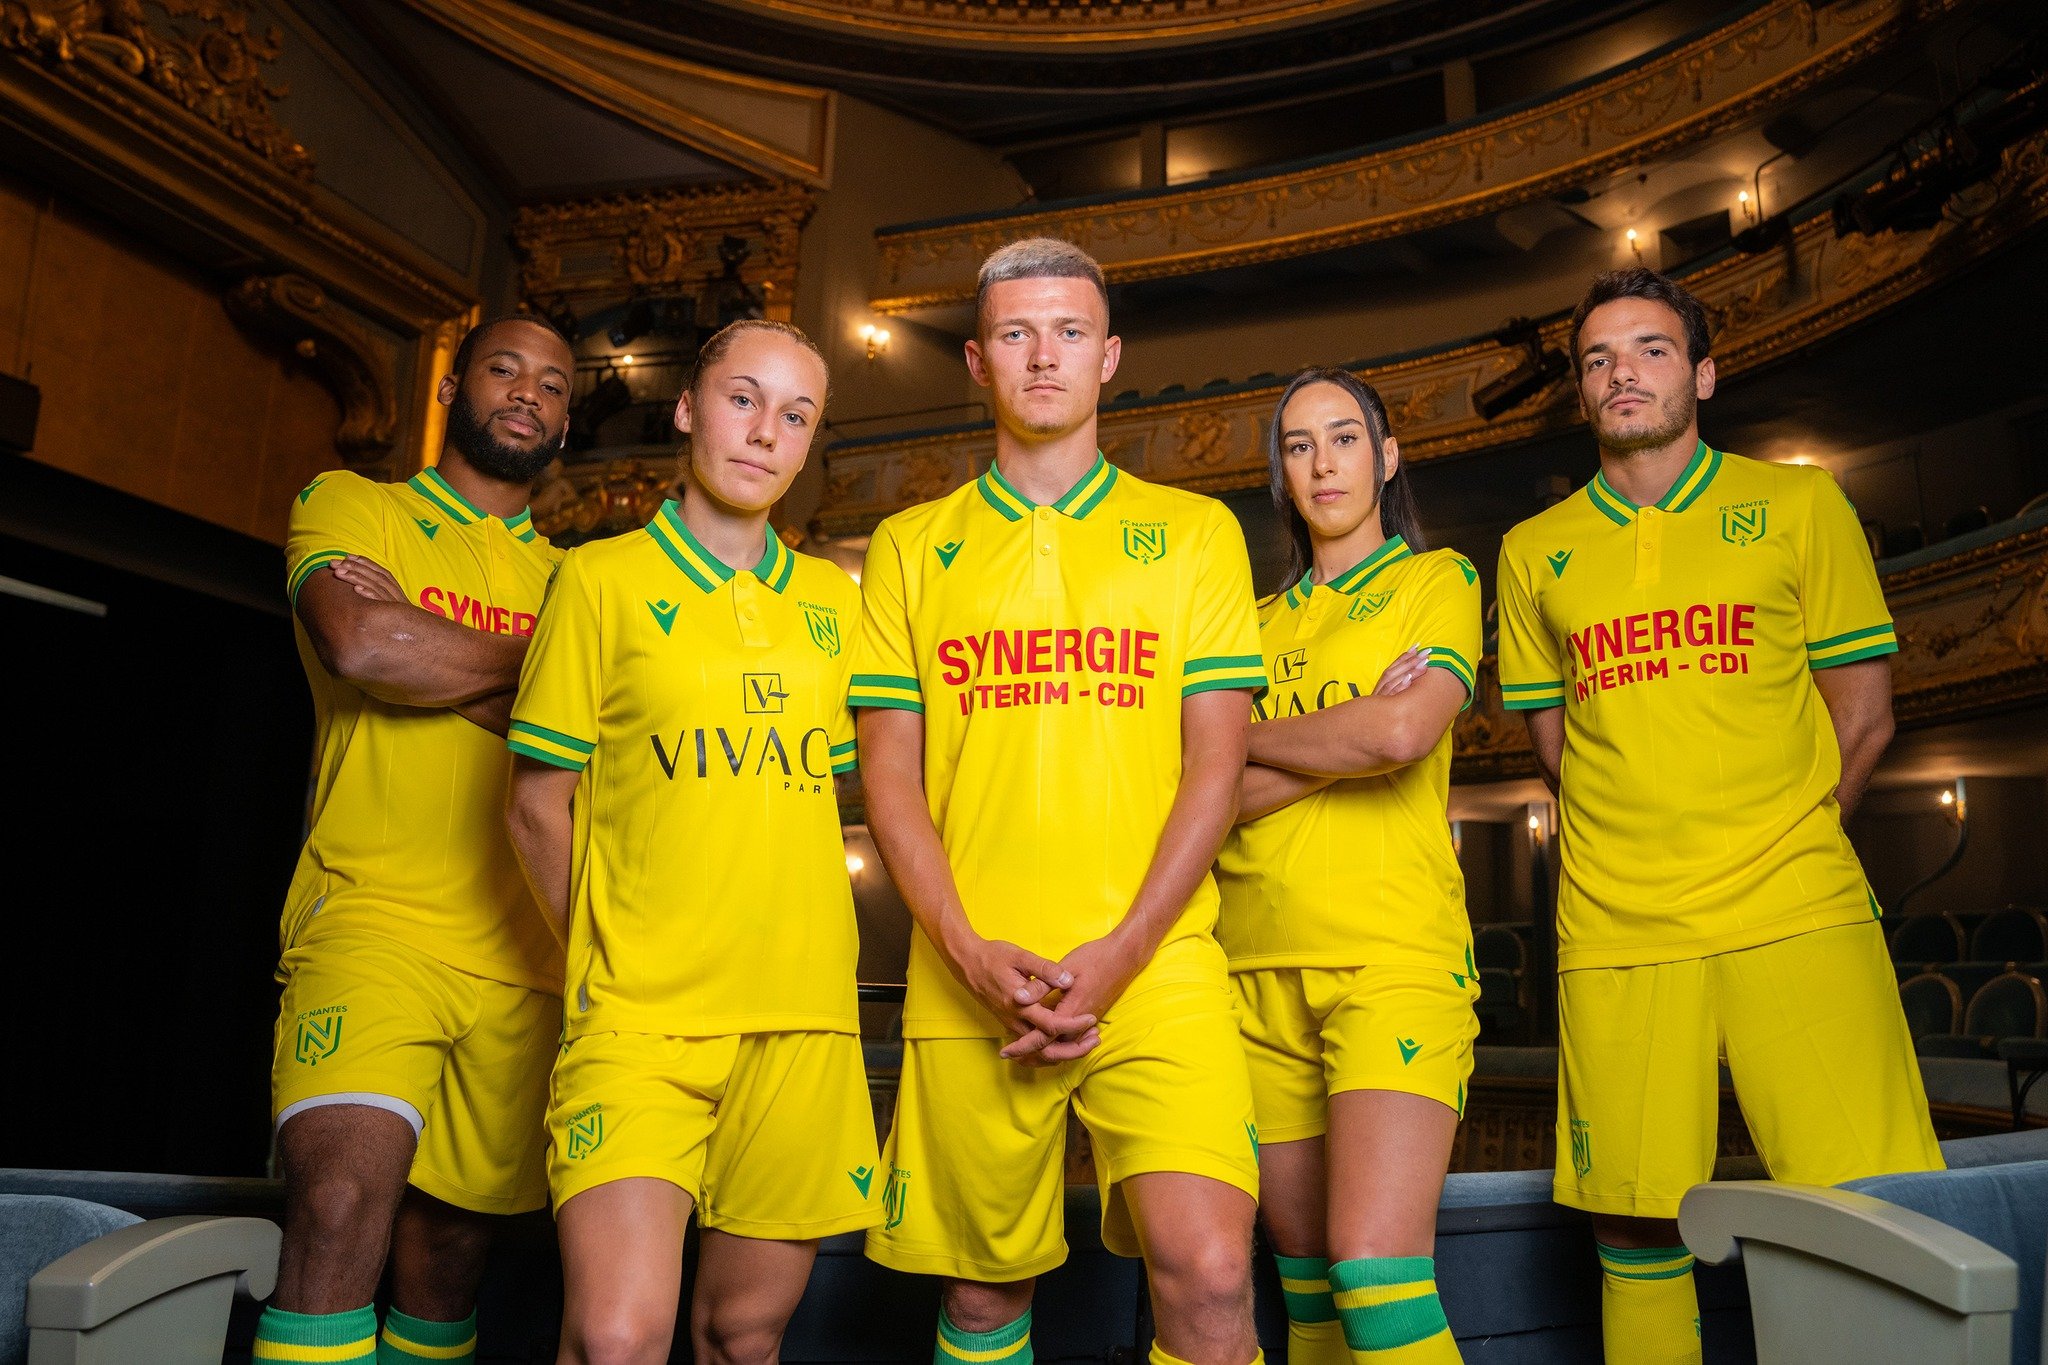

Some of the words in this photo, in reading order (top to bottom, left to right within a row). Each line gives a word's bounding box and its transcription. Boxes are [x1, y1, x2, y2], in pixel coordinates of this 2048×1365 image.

[1732, 499, 1770, 510] NANTES
[937, 626, 1160, 686] SYNERGIE
[1699, 652, 1749, 675] CDI
[1097, 682, 1144, 710] CDI
[297, 1013, 307, 1021] FC
[309, 1005, 348, 1017] NANTES
